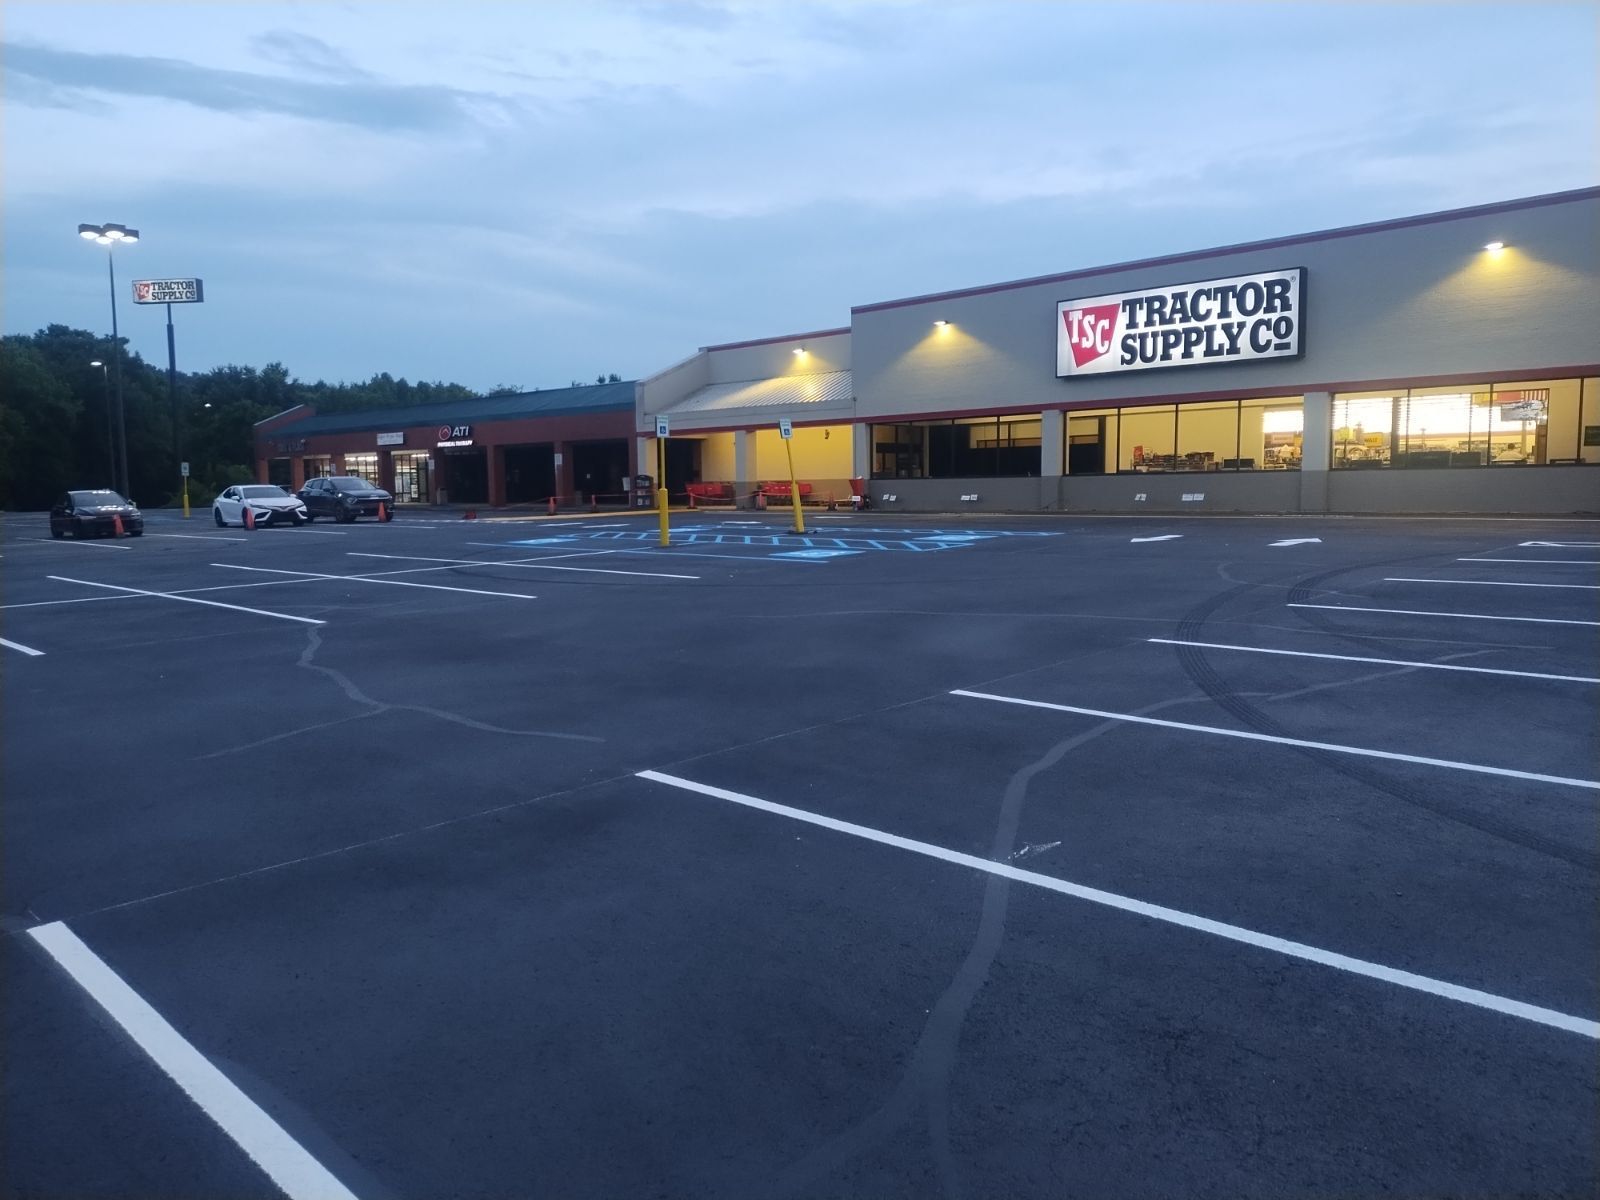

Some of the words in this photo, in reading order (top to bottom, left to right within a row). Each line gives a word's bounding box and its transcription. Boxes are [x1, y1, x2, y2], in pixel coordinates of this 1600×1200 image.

[151, 281, 195, 291] TRACTOR
[151, 291, 184, 300] SUPPLY
[1122, 278, 1293, 330] TRACTOR
[1069, 309, 1110, 354] TSC
[1120, 321, 1247, 366] SUPPLY
[452, 426, 469, 437] ATI
